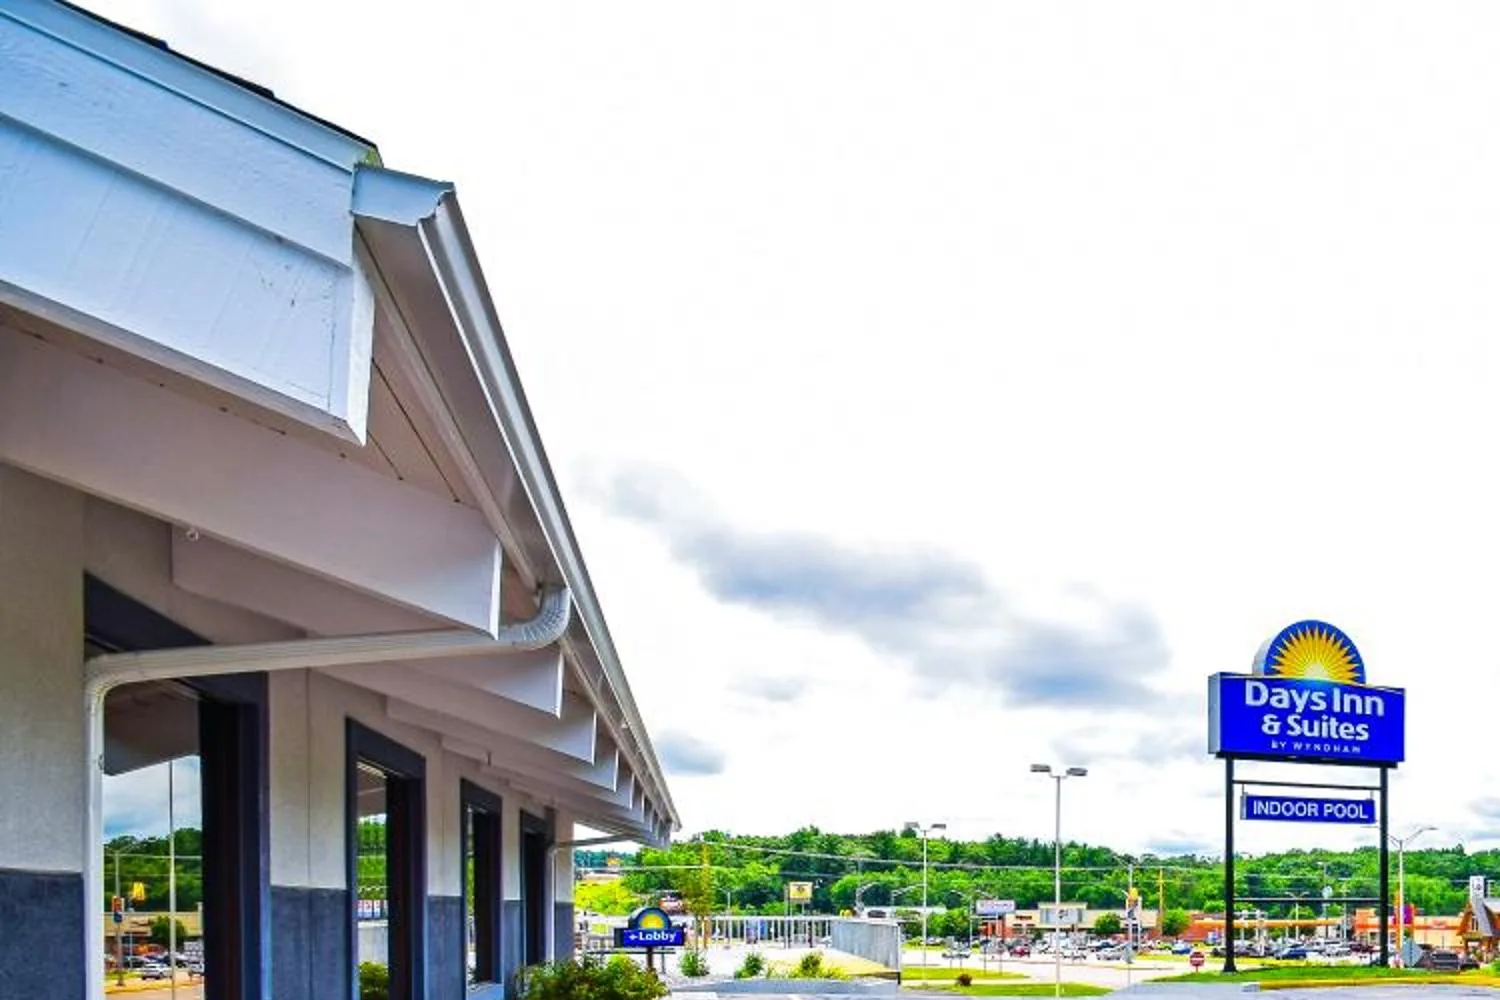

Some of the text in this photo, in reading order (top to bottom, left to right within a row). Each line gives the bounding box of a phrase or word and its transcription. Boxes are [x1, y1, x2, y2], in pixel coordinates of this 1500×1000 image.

[1245, 680, 1385, 716] Days Inn
[1261, 714, 1370, 741] & Suites
[1271, 741, 1361, 753] BY WYNDHAM
[1253, 801, 1369, 819] INDOOR POOL
[639, 931, 676, 943] Lobby
